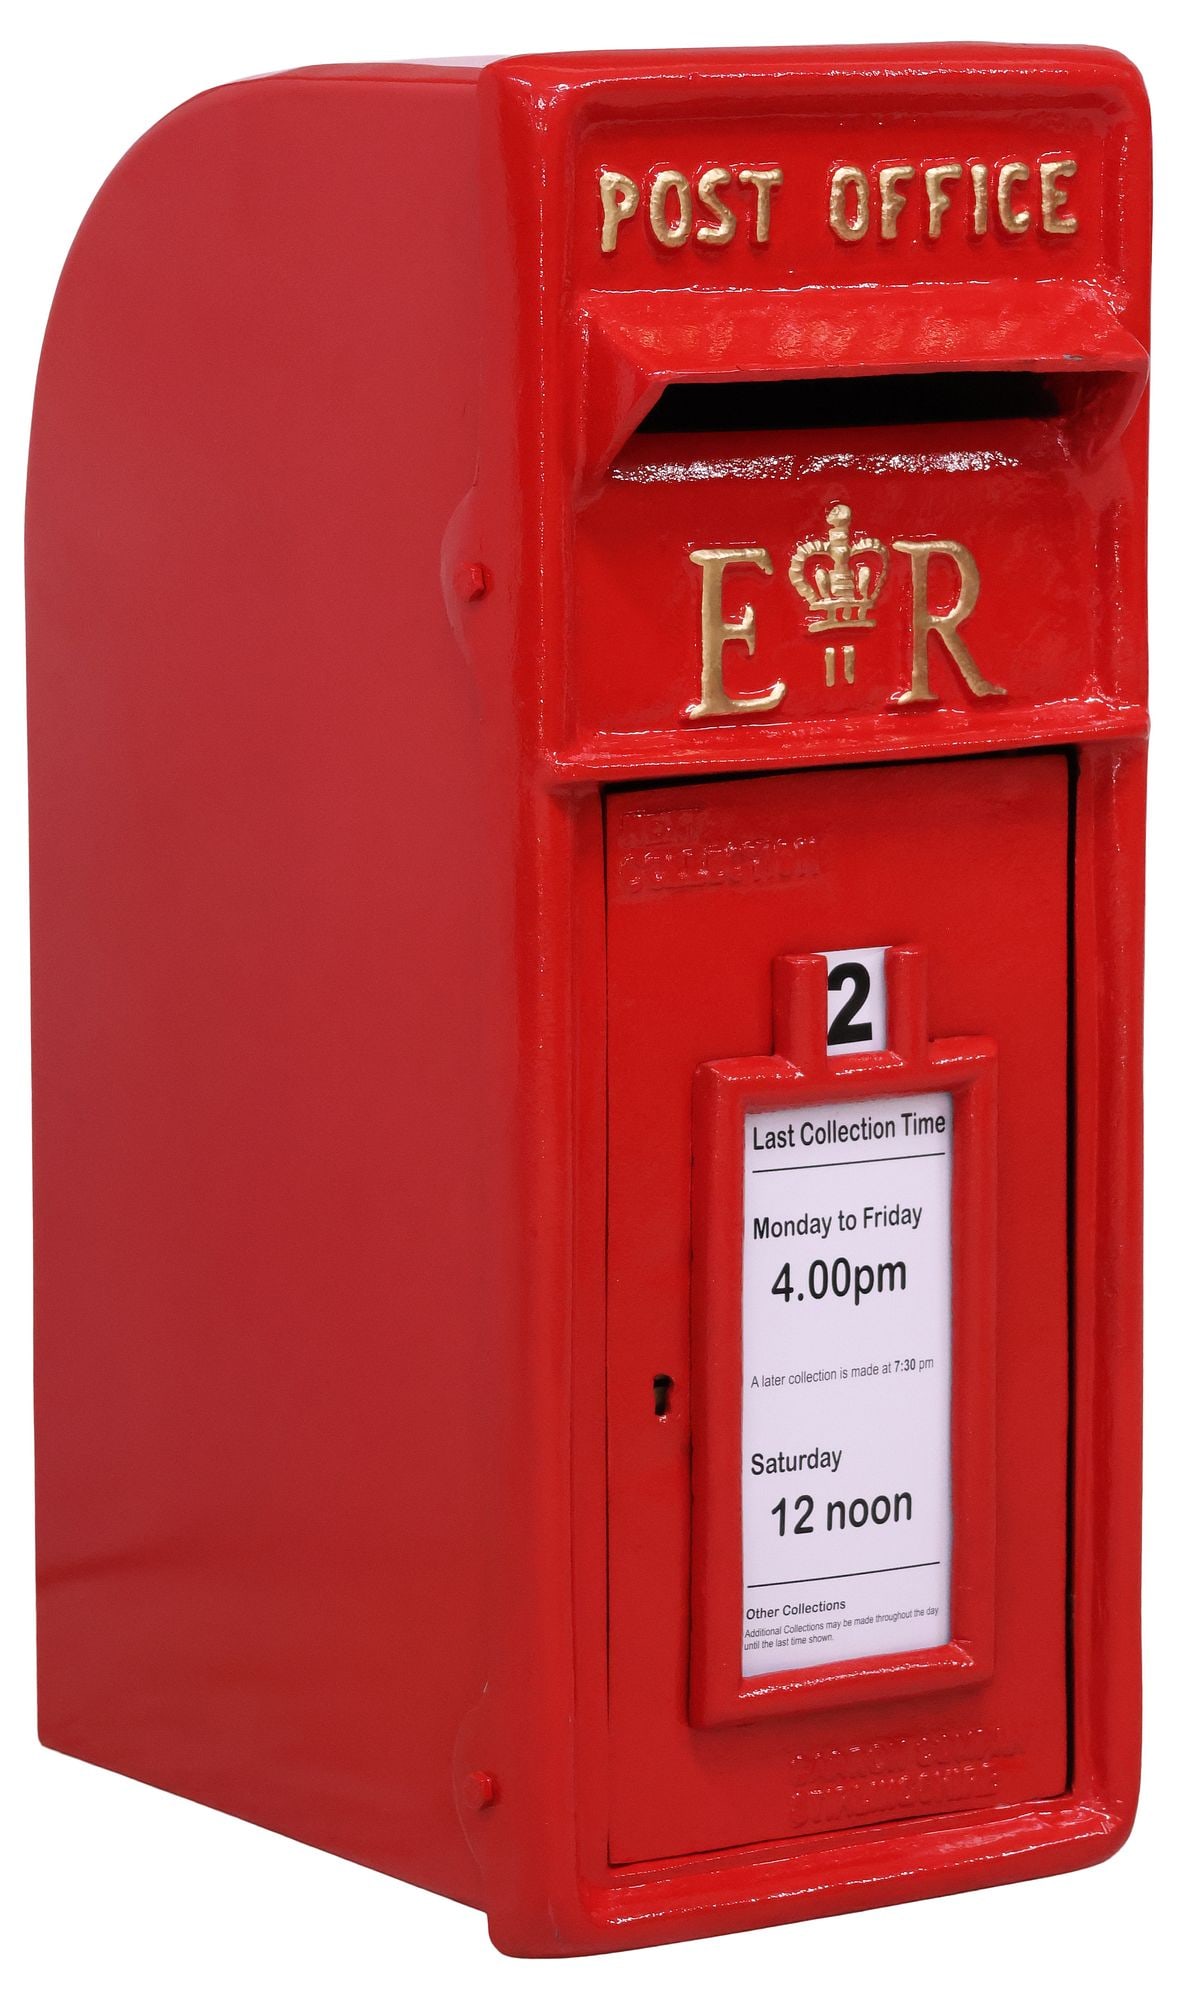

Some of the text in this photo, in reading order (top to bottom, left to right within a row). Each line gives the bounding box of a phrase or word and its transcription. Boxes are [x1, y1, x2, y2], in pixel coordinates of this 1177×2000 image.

[599, 158, 1079, 253] POST OFFICE
[689, 547, 787, 719] E
[892, 539, 1008, 705] R
[827, 962, 872, 1046] 2
[753, 1110, 947, 1150] Last Collection Time
[754, 1204, 922, 1240] Monday to Friday
[771, 1257, 906, 1306] 4.00pm
[751, 1358, 935, 1388] A later collection is made at 7:30 pm
[751, 1447, 842, 1475] Saturday
[771, 1492, 912, 1536] 12 noon
[744, 1606, 940, 1639] Additional Collections may be made throughout the day
[746, 1601, 845, 1620] Other Collections
[744, 1639, 760, 1651] until
[762, 1638, 775, 1649] the
[776, 1636, 789, 1648] last
[790, 1635, 807, 1647] time
